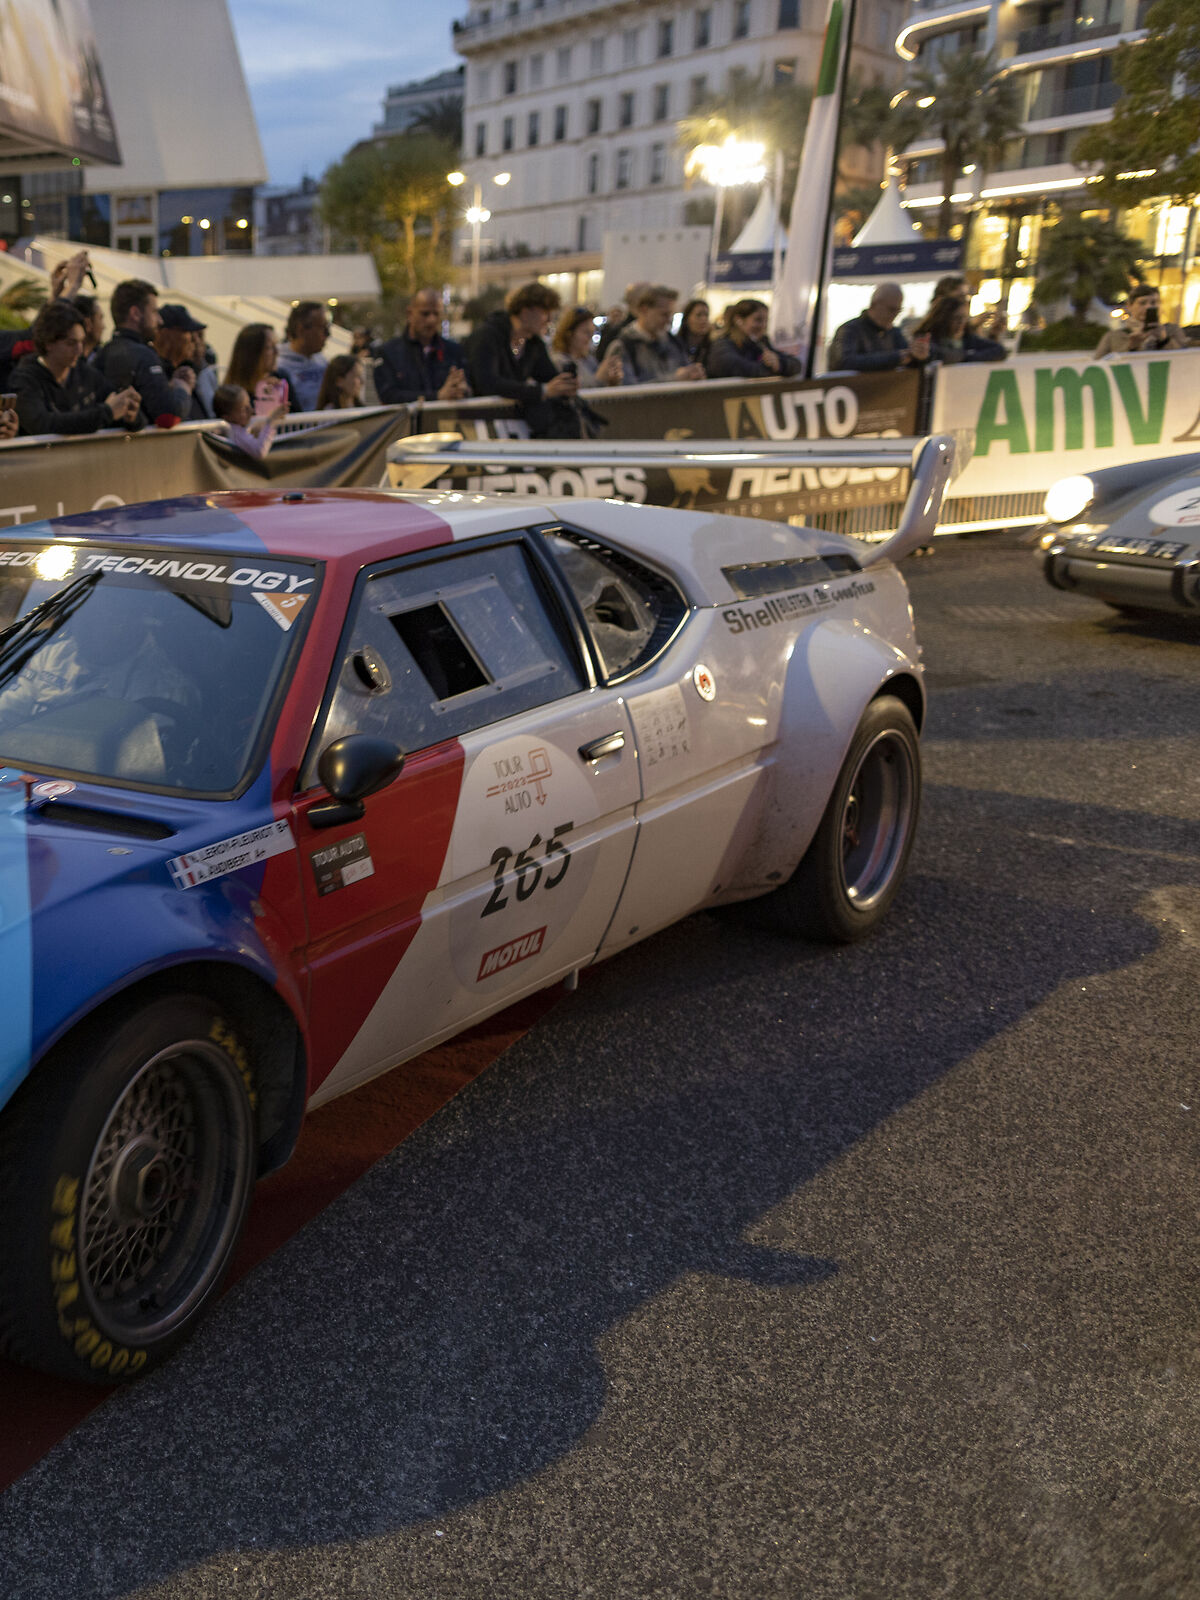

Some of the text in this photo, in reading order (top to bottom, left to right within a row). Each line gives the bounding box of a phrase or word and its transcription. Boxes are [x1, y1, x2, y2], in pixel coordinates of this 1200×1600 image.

[723, 385, 859, 441] AUTO
[81, 554, 316, 594] TECHNOLOGY
[722, 600, 784, 635] Shell
[492, 755, 524, 779] TOUR
[500, 776, 528, 793] 2023
[503, 790, 532, 816] AUTO
[311, 846, 338, 868] TOUR
[479, 820, 575, 920] 265
[481, 929, 545, 977] MOTUL
